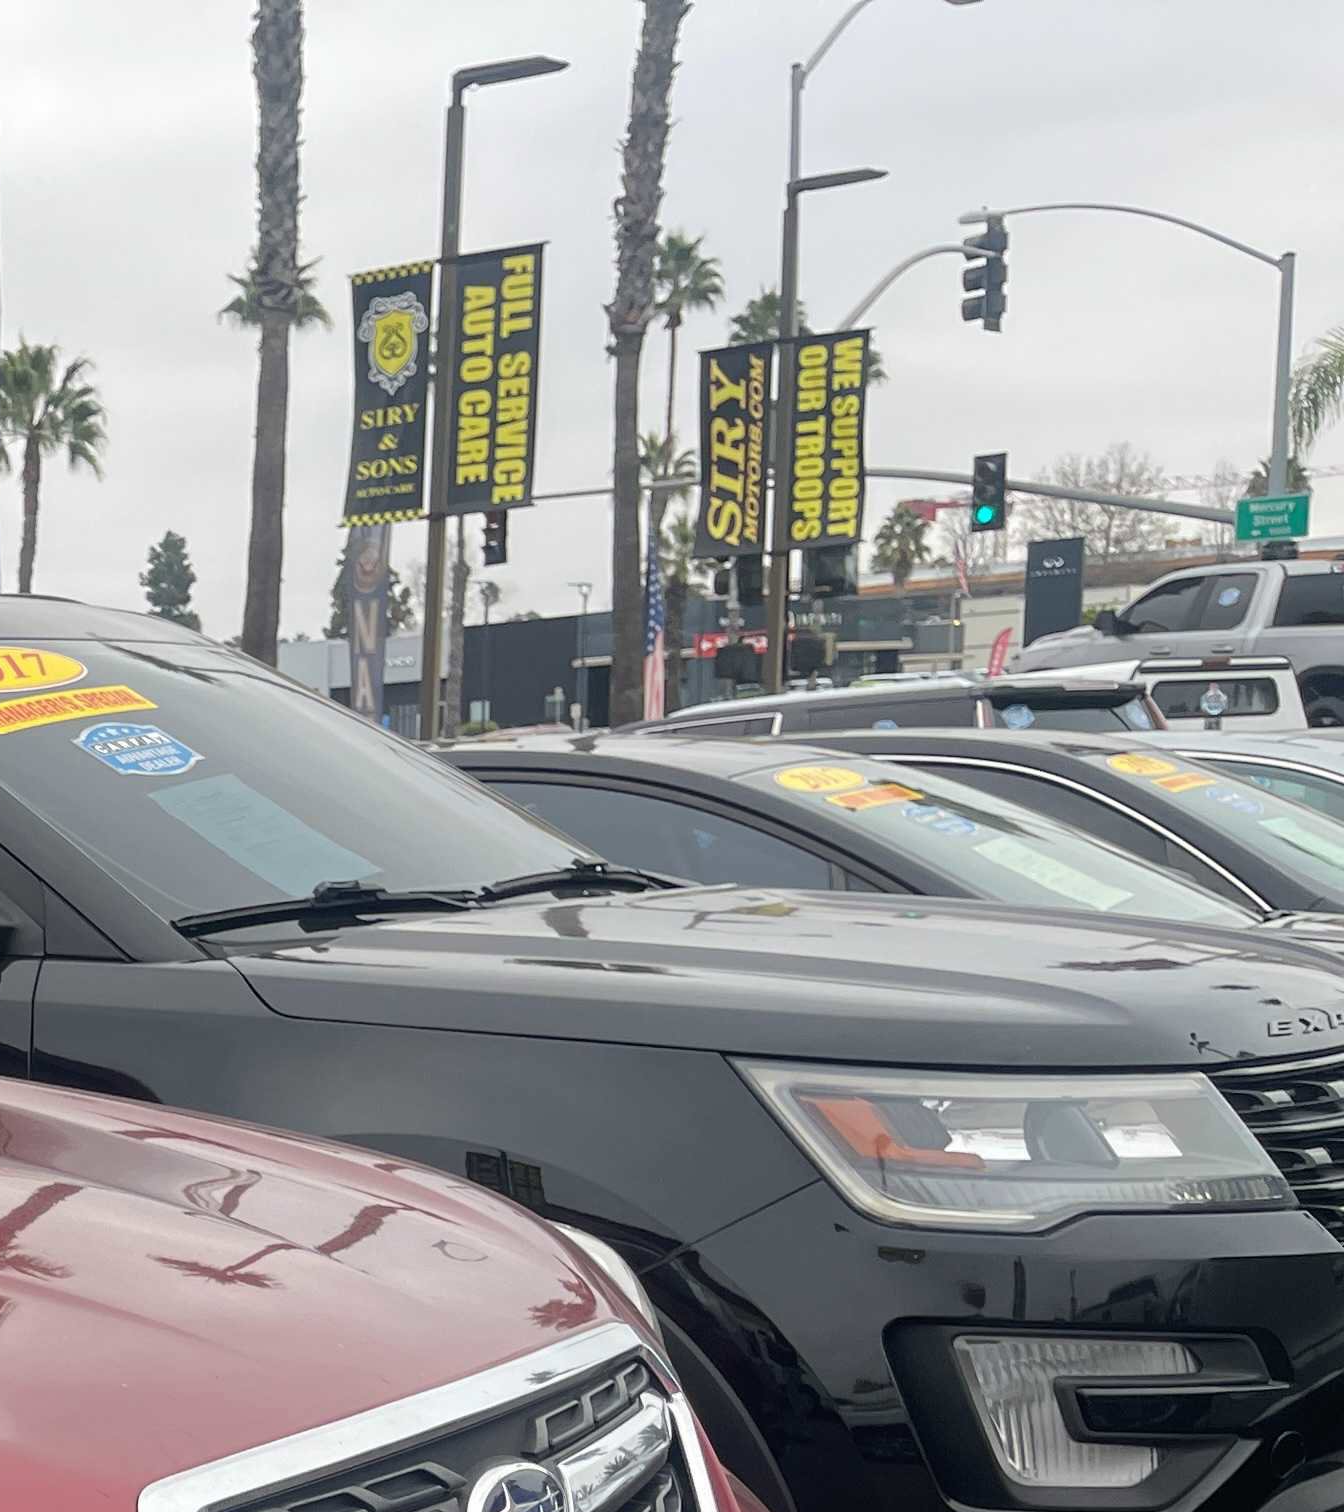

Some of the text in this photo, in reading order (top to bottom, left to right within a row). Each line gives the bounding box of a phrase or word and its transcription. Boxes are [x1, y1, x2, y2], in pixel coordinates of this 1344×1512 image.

[355, 455, 418, 481] SONS
[359, 403, 420, 431] SIRY
[377, 433, 399, 451] &
[455, 285, 496, 486] AUTO CARE
[491, 253, 536, 505] FULL SERVICE
[707, 358, 747, 547] SIRY
[790, 344, 829, 542] OUR TROOPS
[826, 337, 864, 539] WE SUPPORT
[75, 689, 145, 710] SPECIAL
